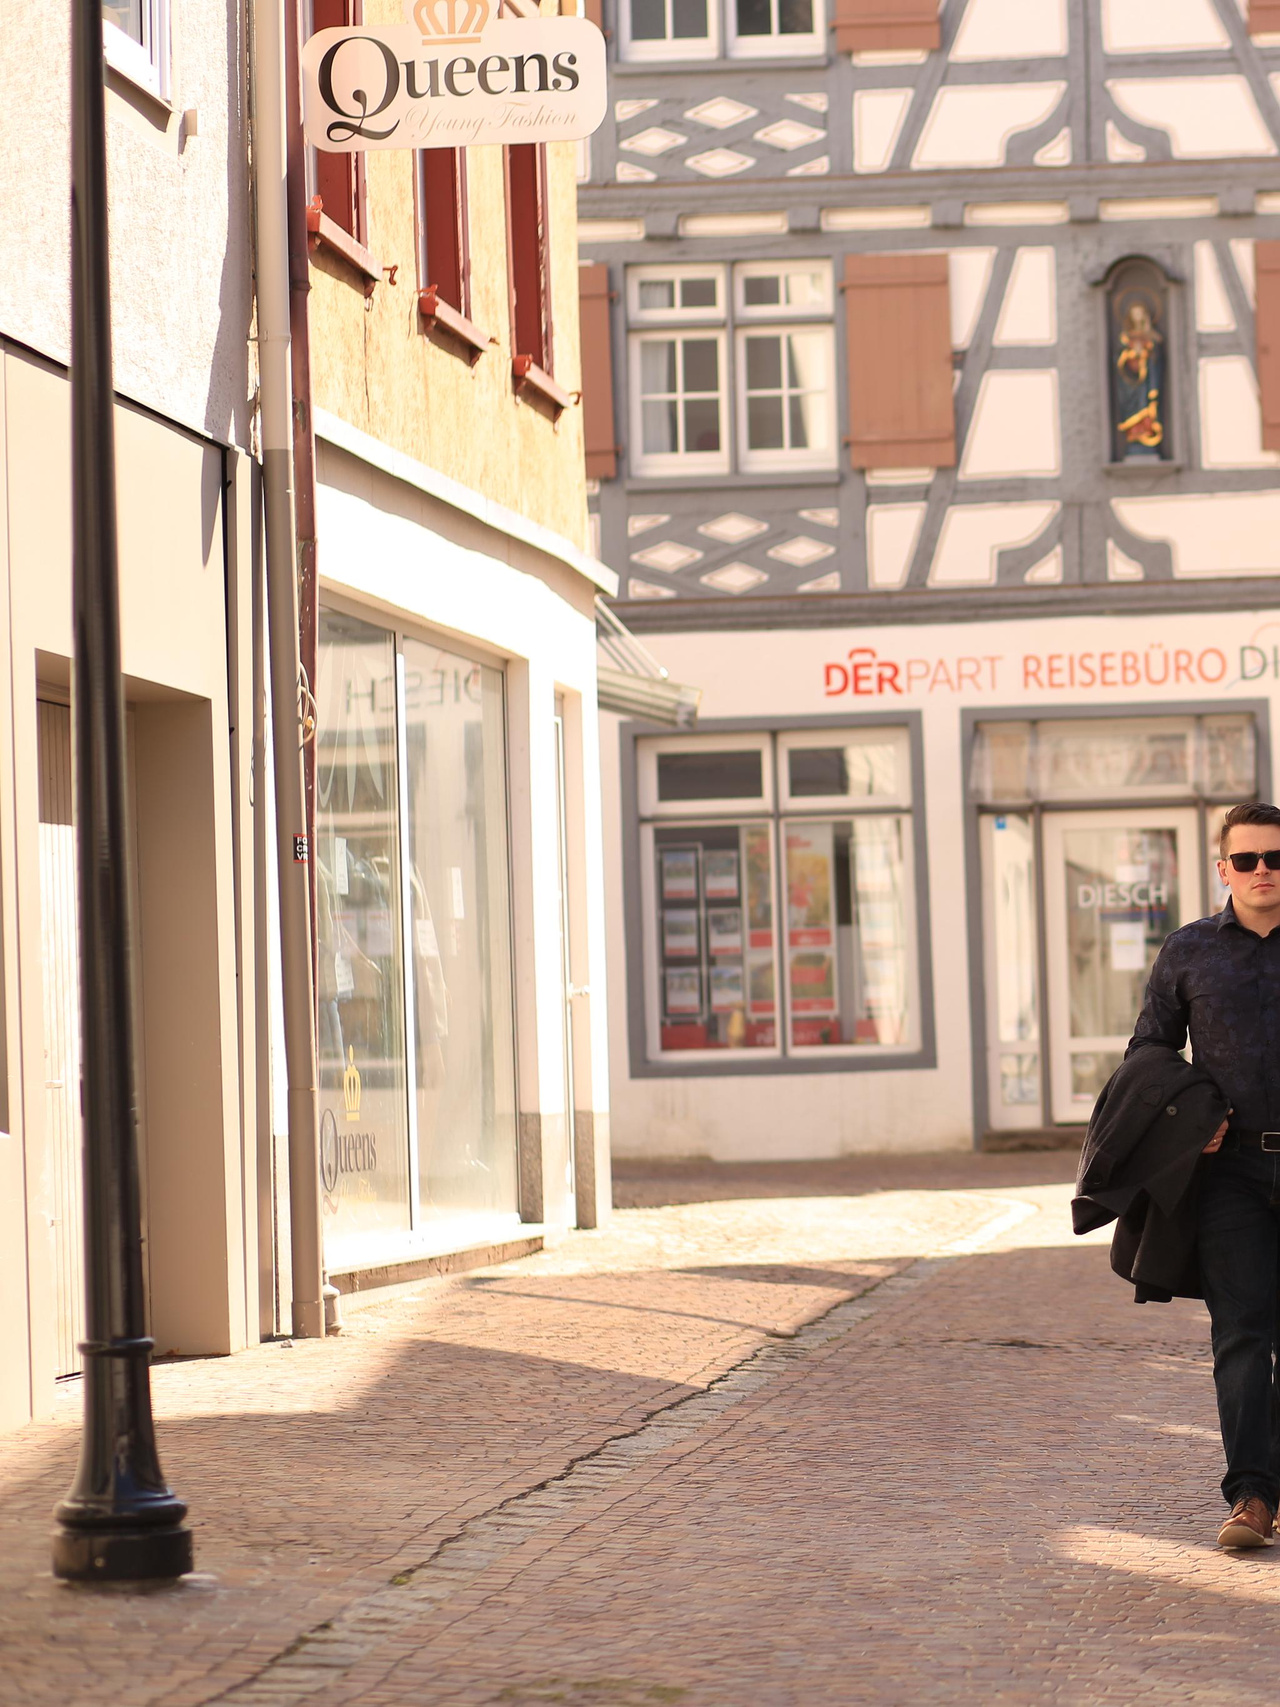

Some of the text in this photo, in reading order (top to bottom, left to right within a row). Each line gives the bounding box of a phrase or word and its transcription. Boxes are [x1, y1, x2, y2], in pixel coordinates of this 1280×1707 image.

[318, 36, 580, 143] Queens
[404, 101, 578, 142] Young Fashion
[1023, 642, 1228, 689] REISEBÜRO
[1078, 882, 1168, 909] DIESCH
[320, 1108, 377, 1216] Queens
